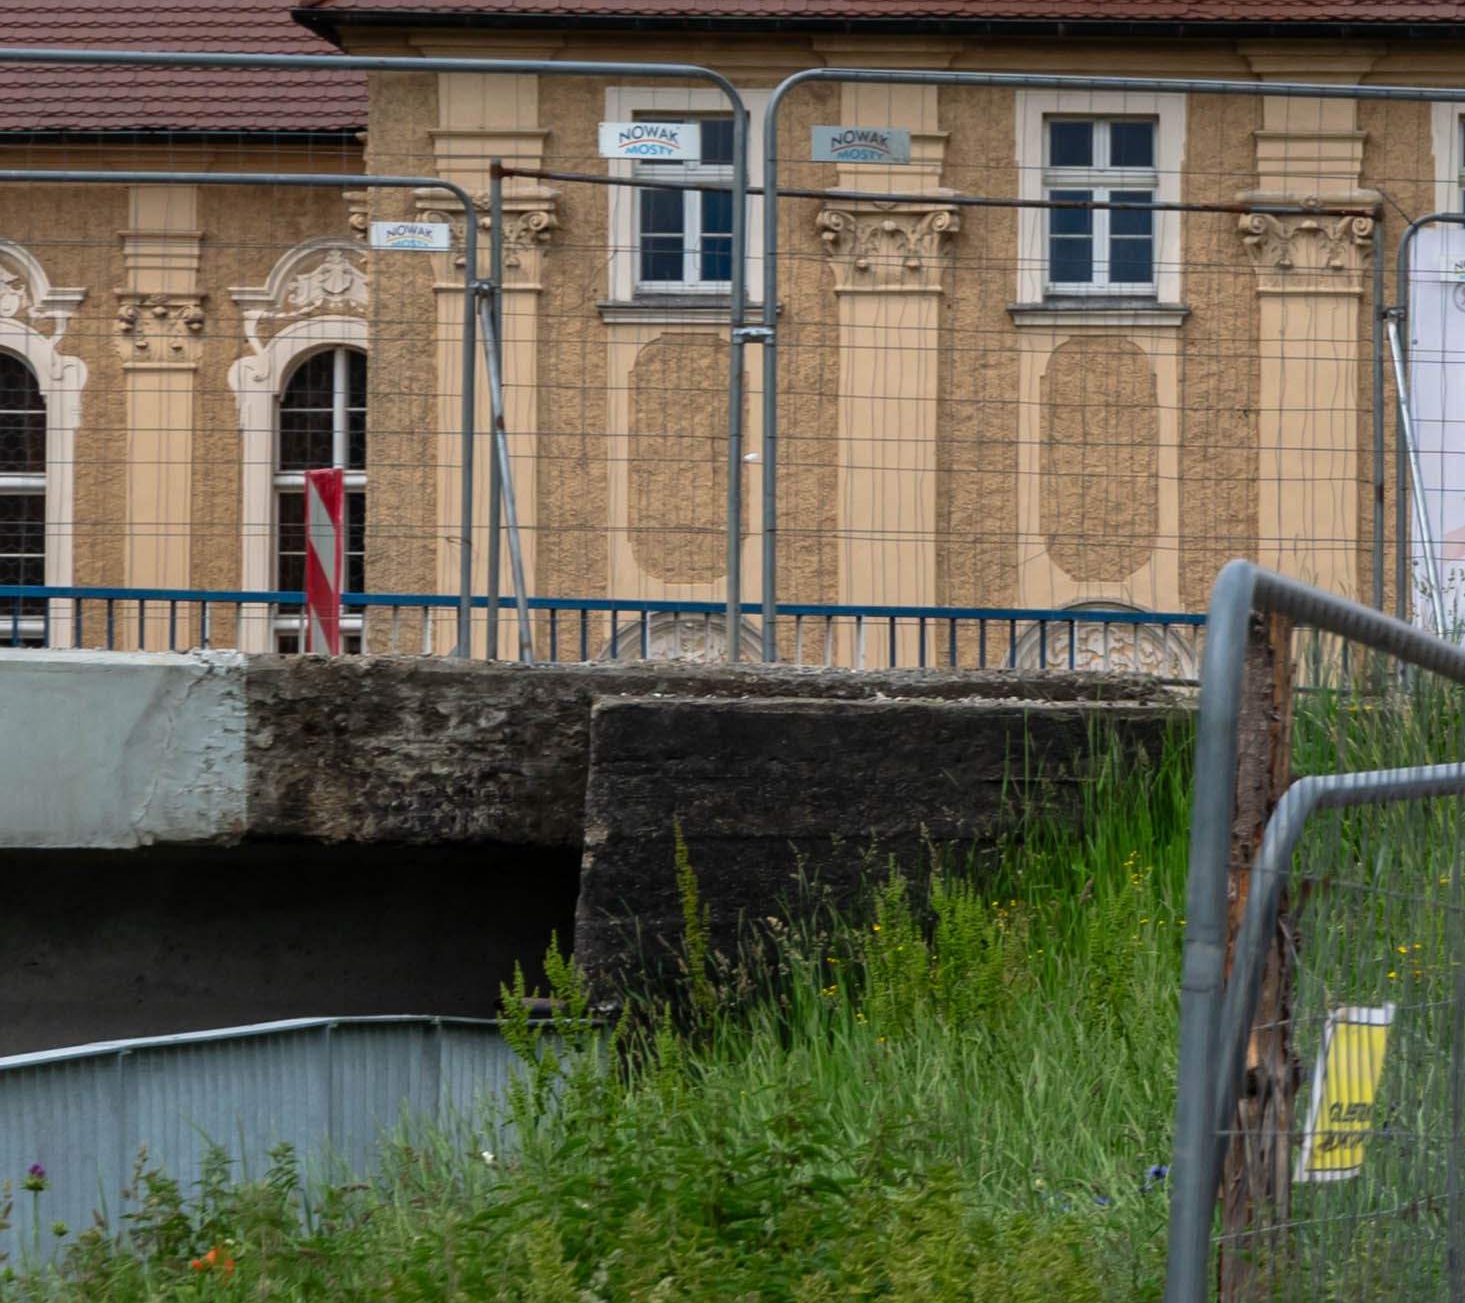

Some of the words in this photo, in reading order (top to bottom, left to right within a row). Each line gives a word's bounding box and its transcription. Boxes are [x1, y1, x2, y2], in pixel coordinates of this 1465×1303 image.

[618, 125, 679, 144] NOWAK
[831, 130, 889, 148] NOWAK
[624, 144, 674, 155] MOSTY
[385, 224, 433, 240] NOWAK
